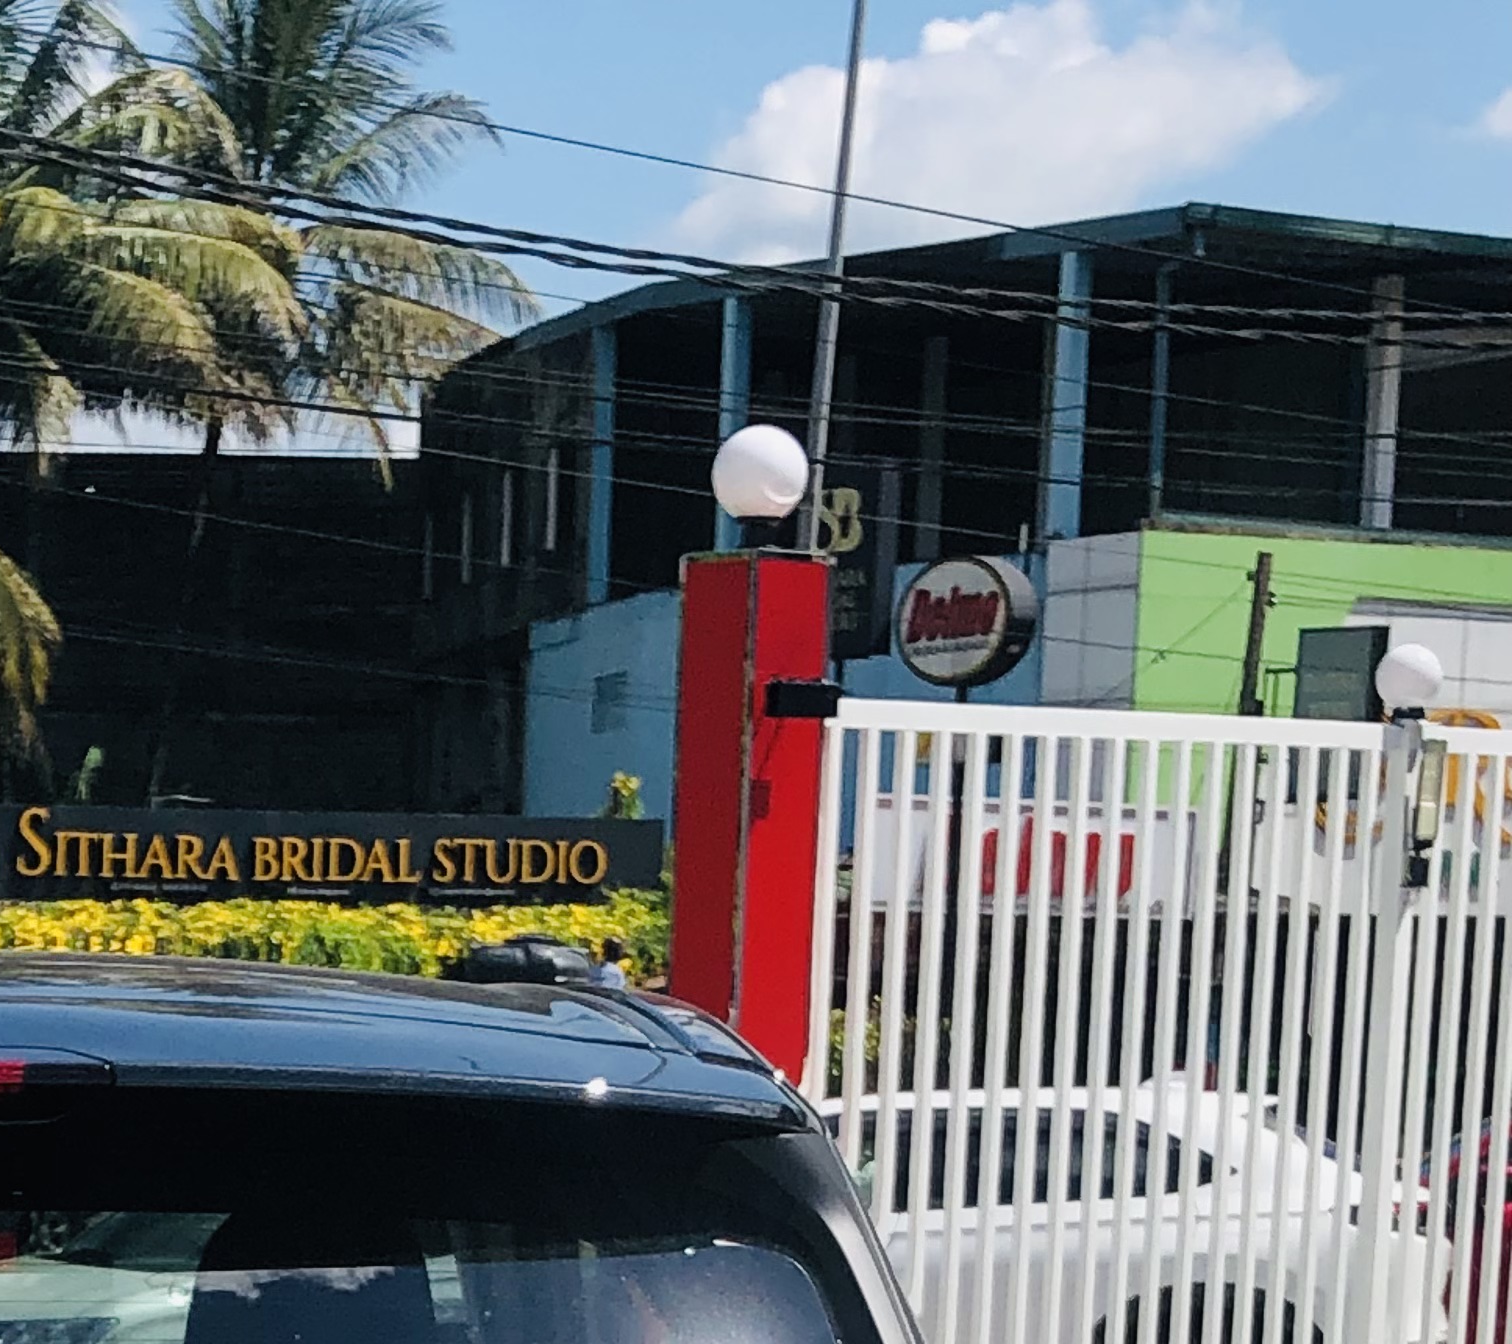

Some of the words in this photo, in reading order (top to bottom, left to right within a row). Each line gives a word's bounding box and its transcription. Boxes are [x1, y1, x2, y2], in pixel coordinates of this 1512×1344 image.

[16, 806, 239, 881] SITHARA
[251, 834, 422, 884] BRIDAL
[431, 836, 610, 885] STUDIO
